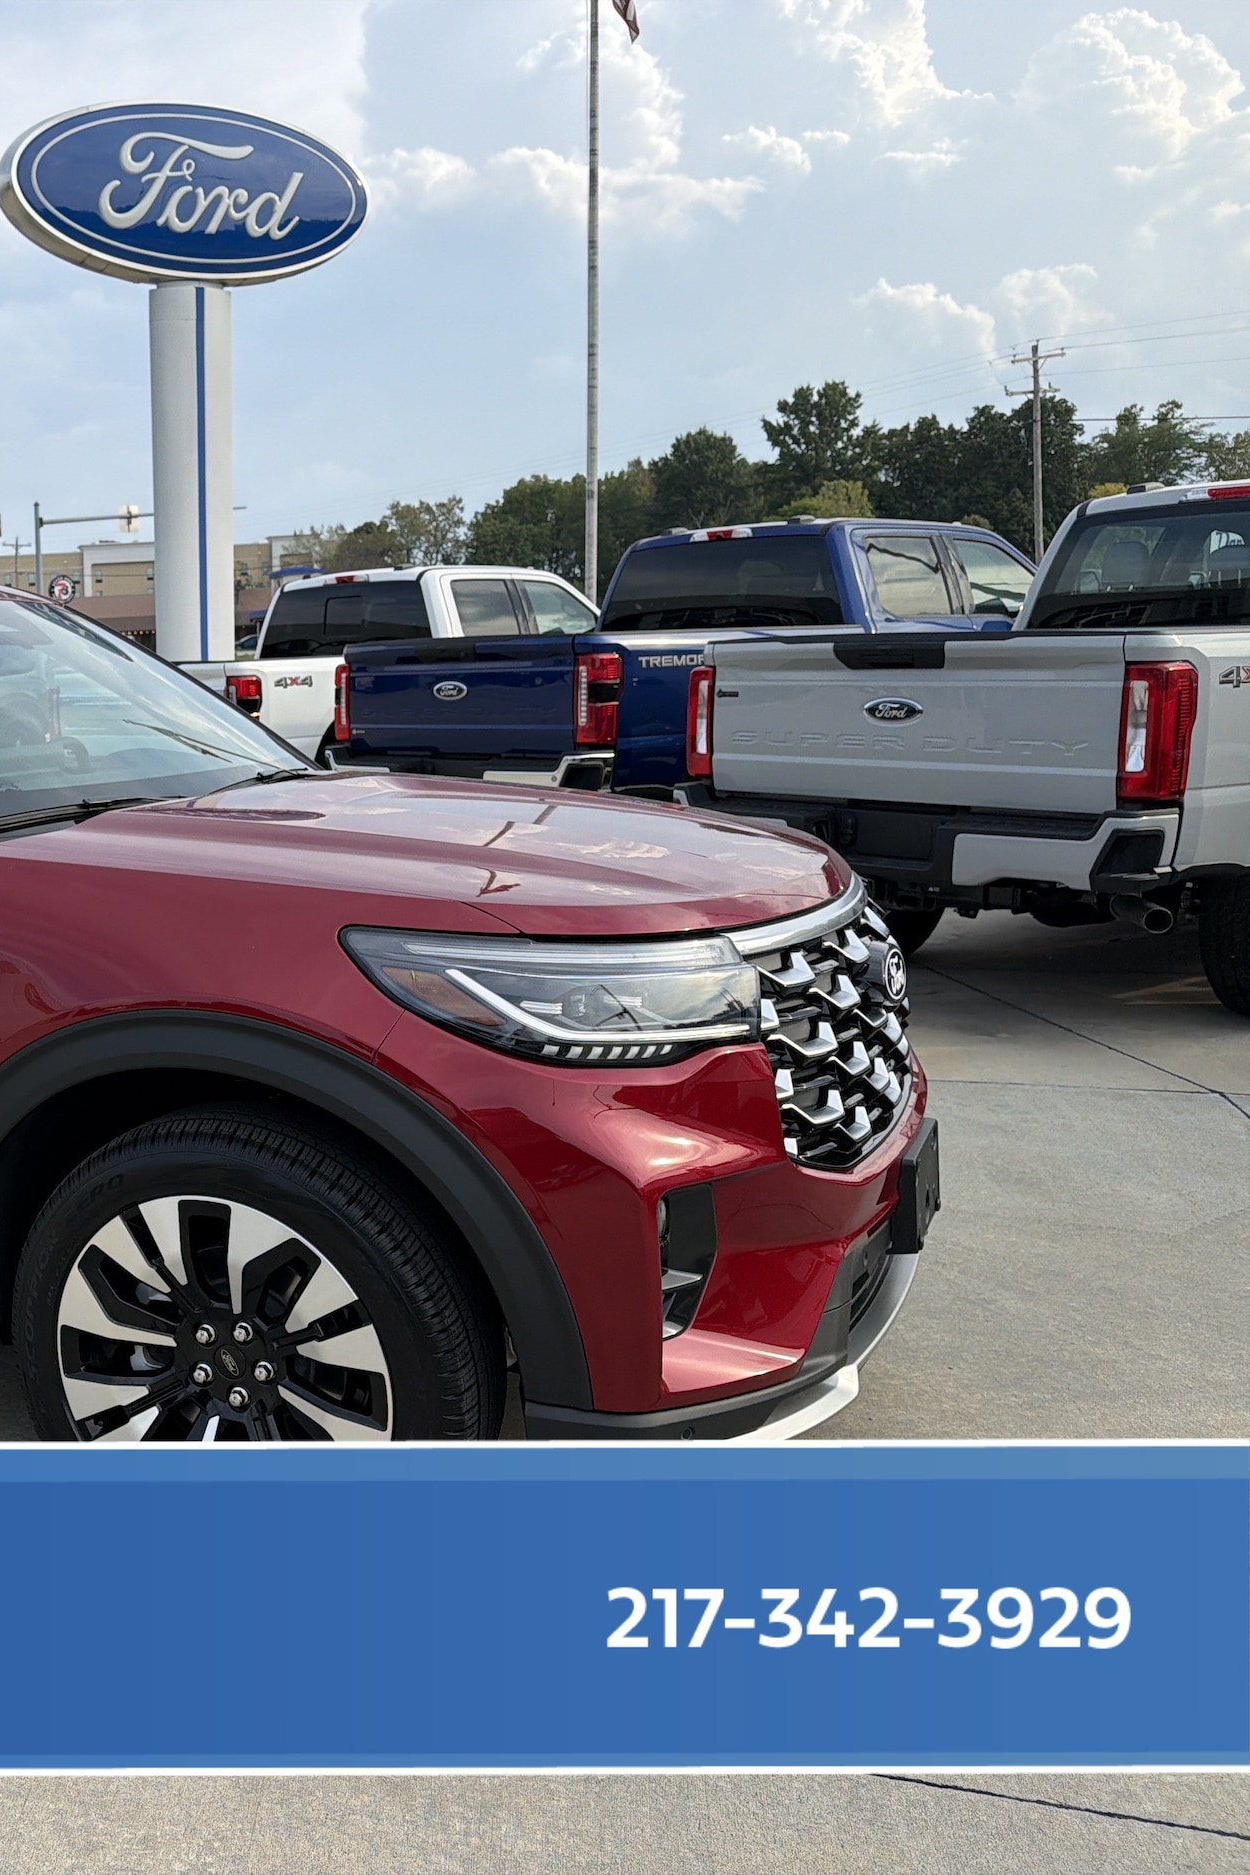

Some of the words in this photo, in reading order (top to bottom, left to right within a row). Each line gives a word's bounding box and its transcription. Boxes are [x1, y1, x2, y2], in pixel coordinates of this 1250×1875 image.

[99, 131, 304, 241] Ford
[875, 702, 908, 718] Ford
[731, 730, 905, 751] SUPER
[920, 735, 1090, 757] DUTY
